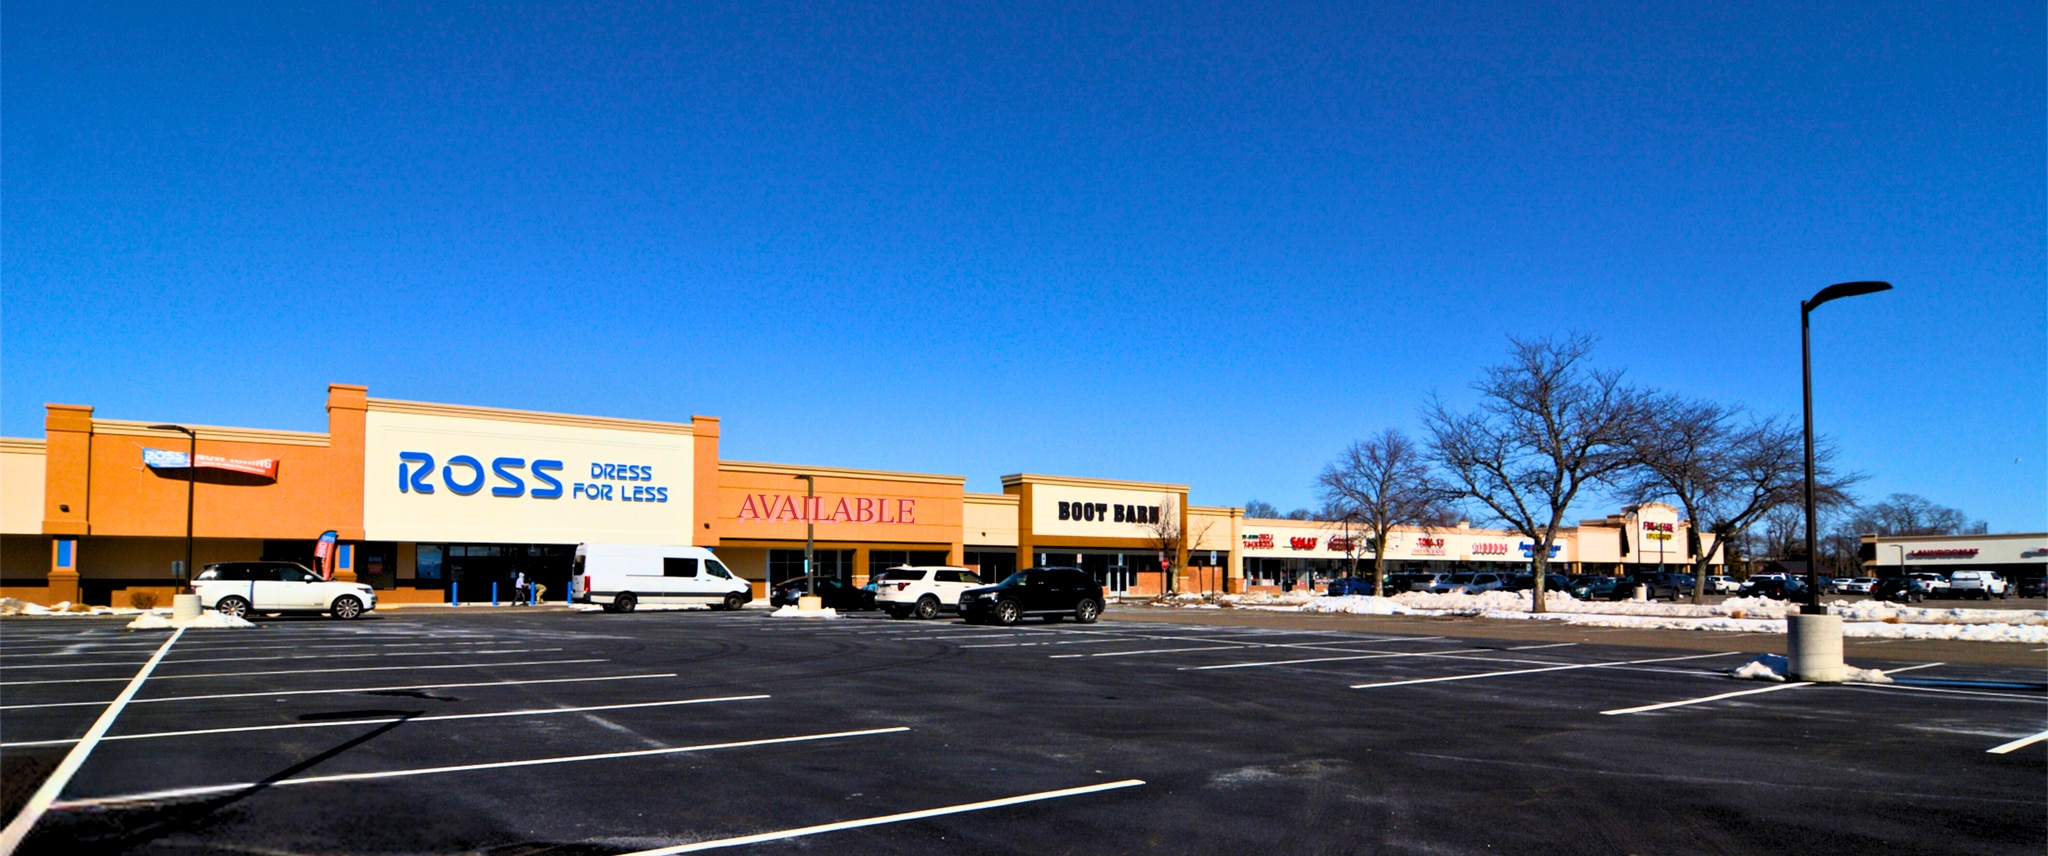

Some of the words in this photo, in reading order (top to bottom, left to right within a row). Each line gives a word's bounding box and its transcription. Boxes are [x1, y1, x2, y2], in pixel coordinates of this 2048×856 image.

[145, 450, 185, 461] ROSS
[399, 451, 563, 499] ROSS
[591, 463, 652, 481] DRESS
[573, 483, 613, 501] FOR
[621, 485, 668, 503] LESS
[737, 493, 916, 524] AVAILABLE
[1058, 501, 1107, 522] BOOT
[1113, 504, 1160, 524] BARN
[1290, 536, 1318, 550] SALLY
[1911, 548, 1979, 557] LAUNDROMAT
